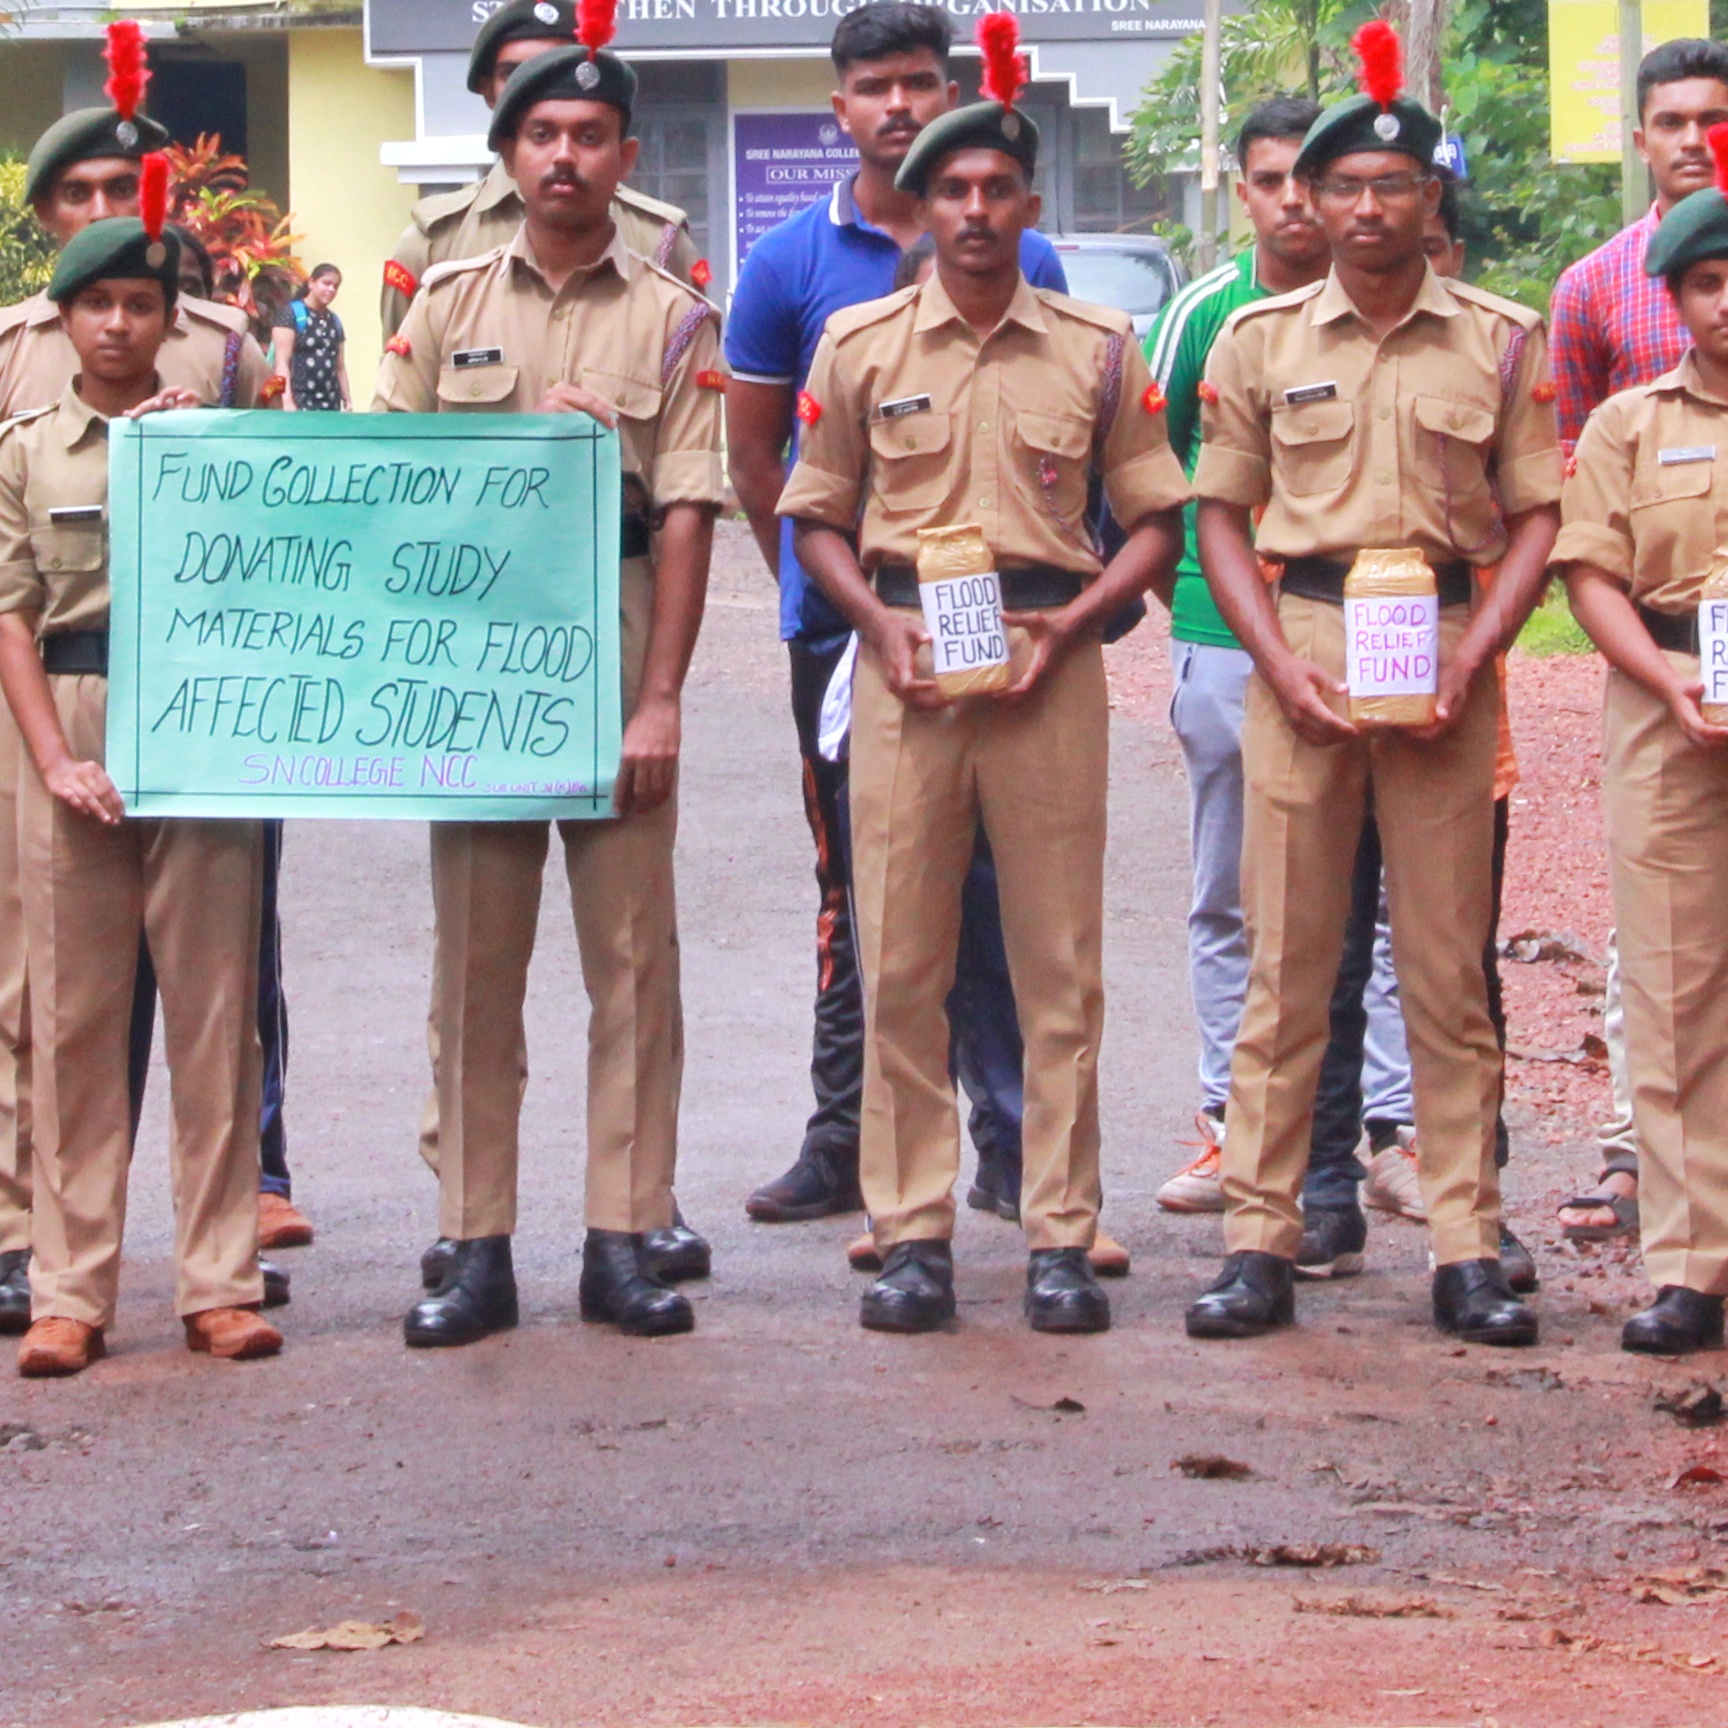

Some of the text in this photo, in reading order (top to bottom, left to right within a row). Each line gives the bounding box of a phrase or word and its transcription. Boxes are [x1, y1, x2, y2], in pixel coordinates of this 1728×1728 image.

[1111, 18, 1206, 32] SREE NARAYANA
[745, 147, 860, 160] SREE NARAYANA COLLE
[770, 168, 808, 181] OUR
[152, 453, 550, 510] FUND COLLECTION FOR
[174, 530, 511, 601] DONATING STUDY
[935, 577, 997, 611] FLOOD
[938, 606, 1000, 638] RELIEF
[1354, 603, 1427, 627] FLOOD
[165, 607, 594, 683] MATERIALS FOR FLOOD
[944, 634, 1004, 667] FUND
[1355, 630, 1429, 652] RELIEF
[1358, 654, 1432, 683] FUND
[151, 675, 575, 757] AFFECTED STUDENTS
[419, 754, 478, 790] NCC
